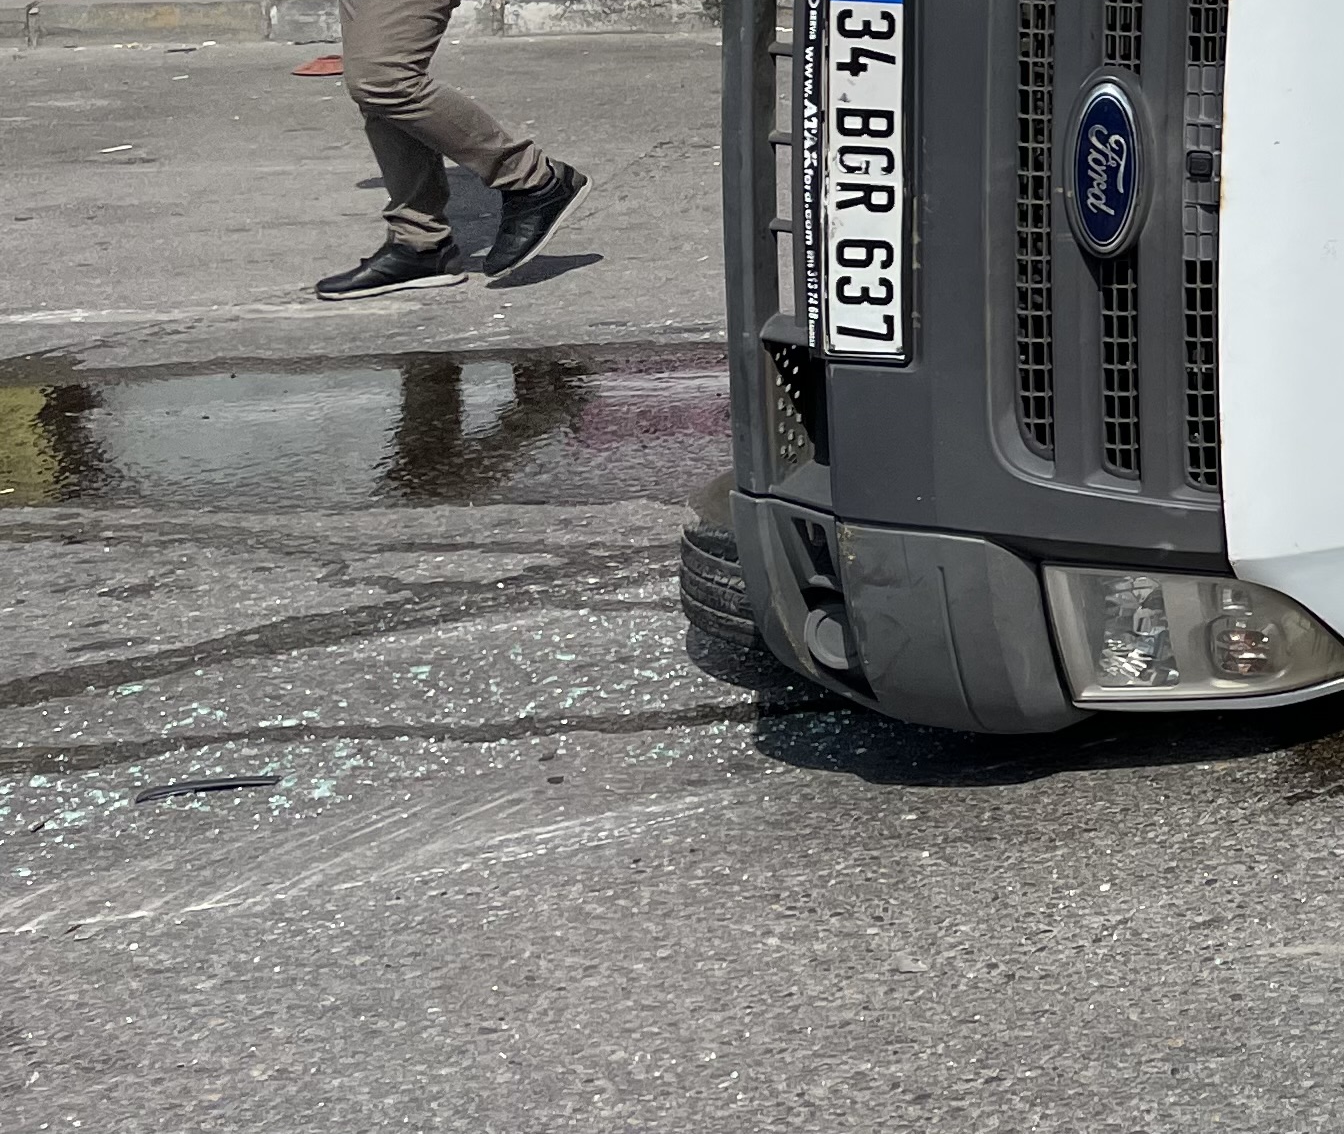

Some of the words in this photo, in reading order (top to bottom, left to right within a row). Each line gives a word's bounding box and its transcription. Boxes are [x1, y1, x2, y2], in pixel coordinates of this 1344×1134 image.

[835, 8, 897, 77] 34
[835, 107, 895, 213] BGR
[1087, 124, 1127, 216] Ford
[835, 238, 895, 342] 637
